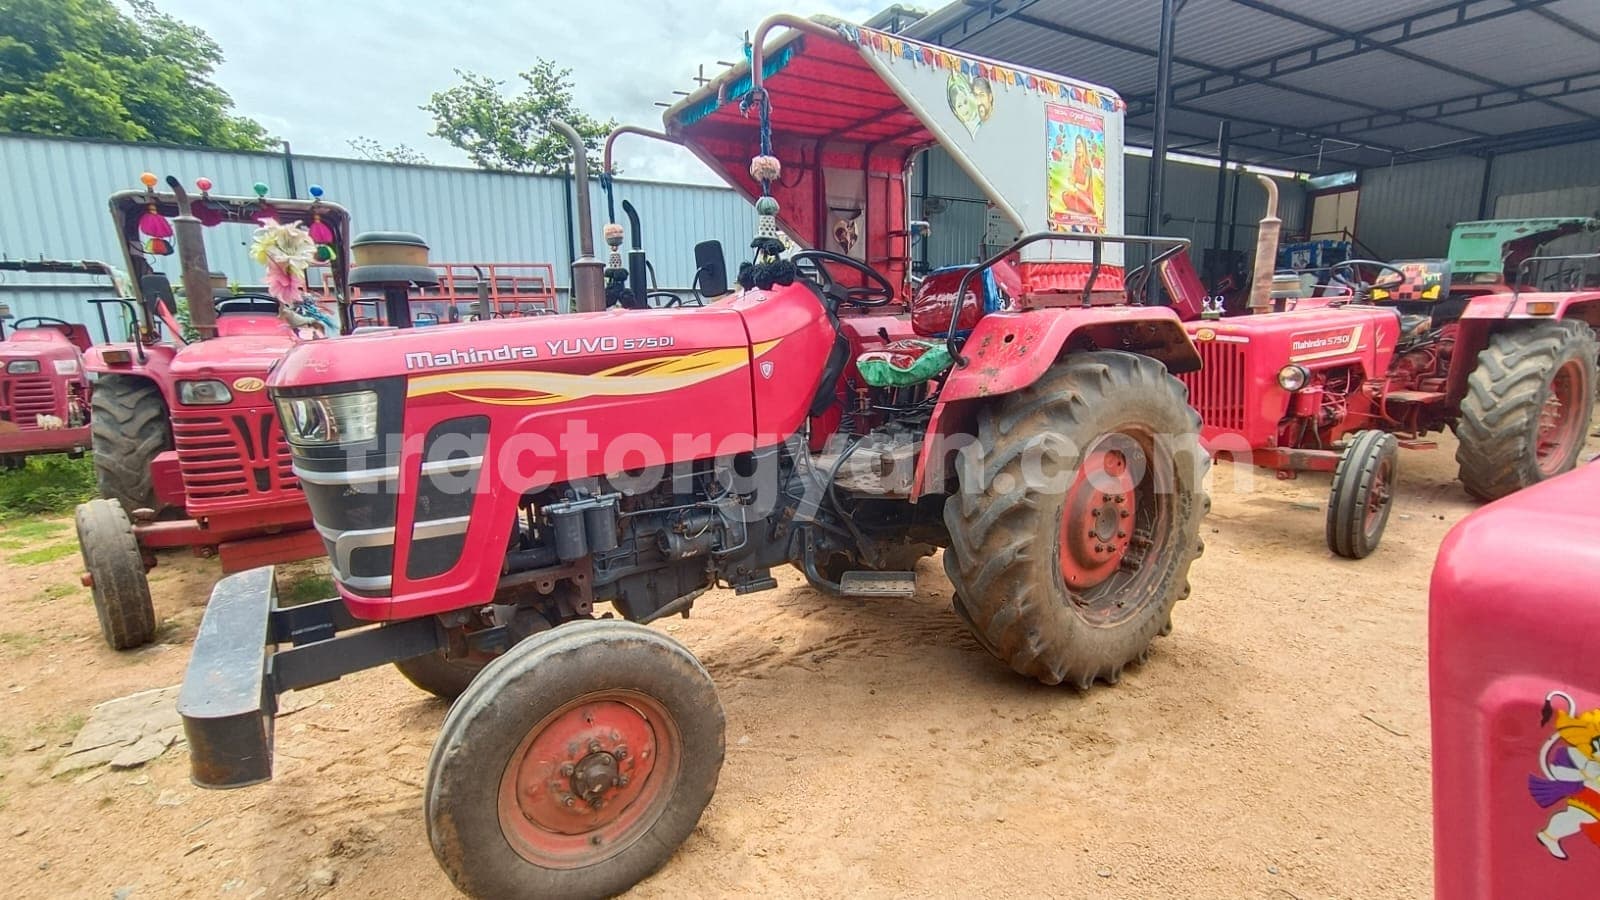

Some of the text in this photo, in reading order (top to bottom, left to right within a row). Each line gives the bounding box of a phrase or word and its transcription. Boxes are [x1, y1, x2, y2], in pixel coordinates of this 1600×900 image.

[405, 336, 675, 369] Mahindra YUVO 575DI
[1292, 338, 1327, 350] Mahindra
